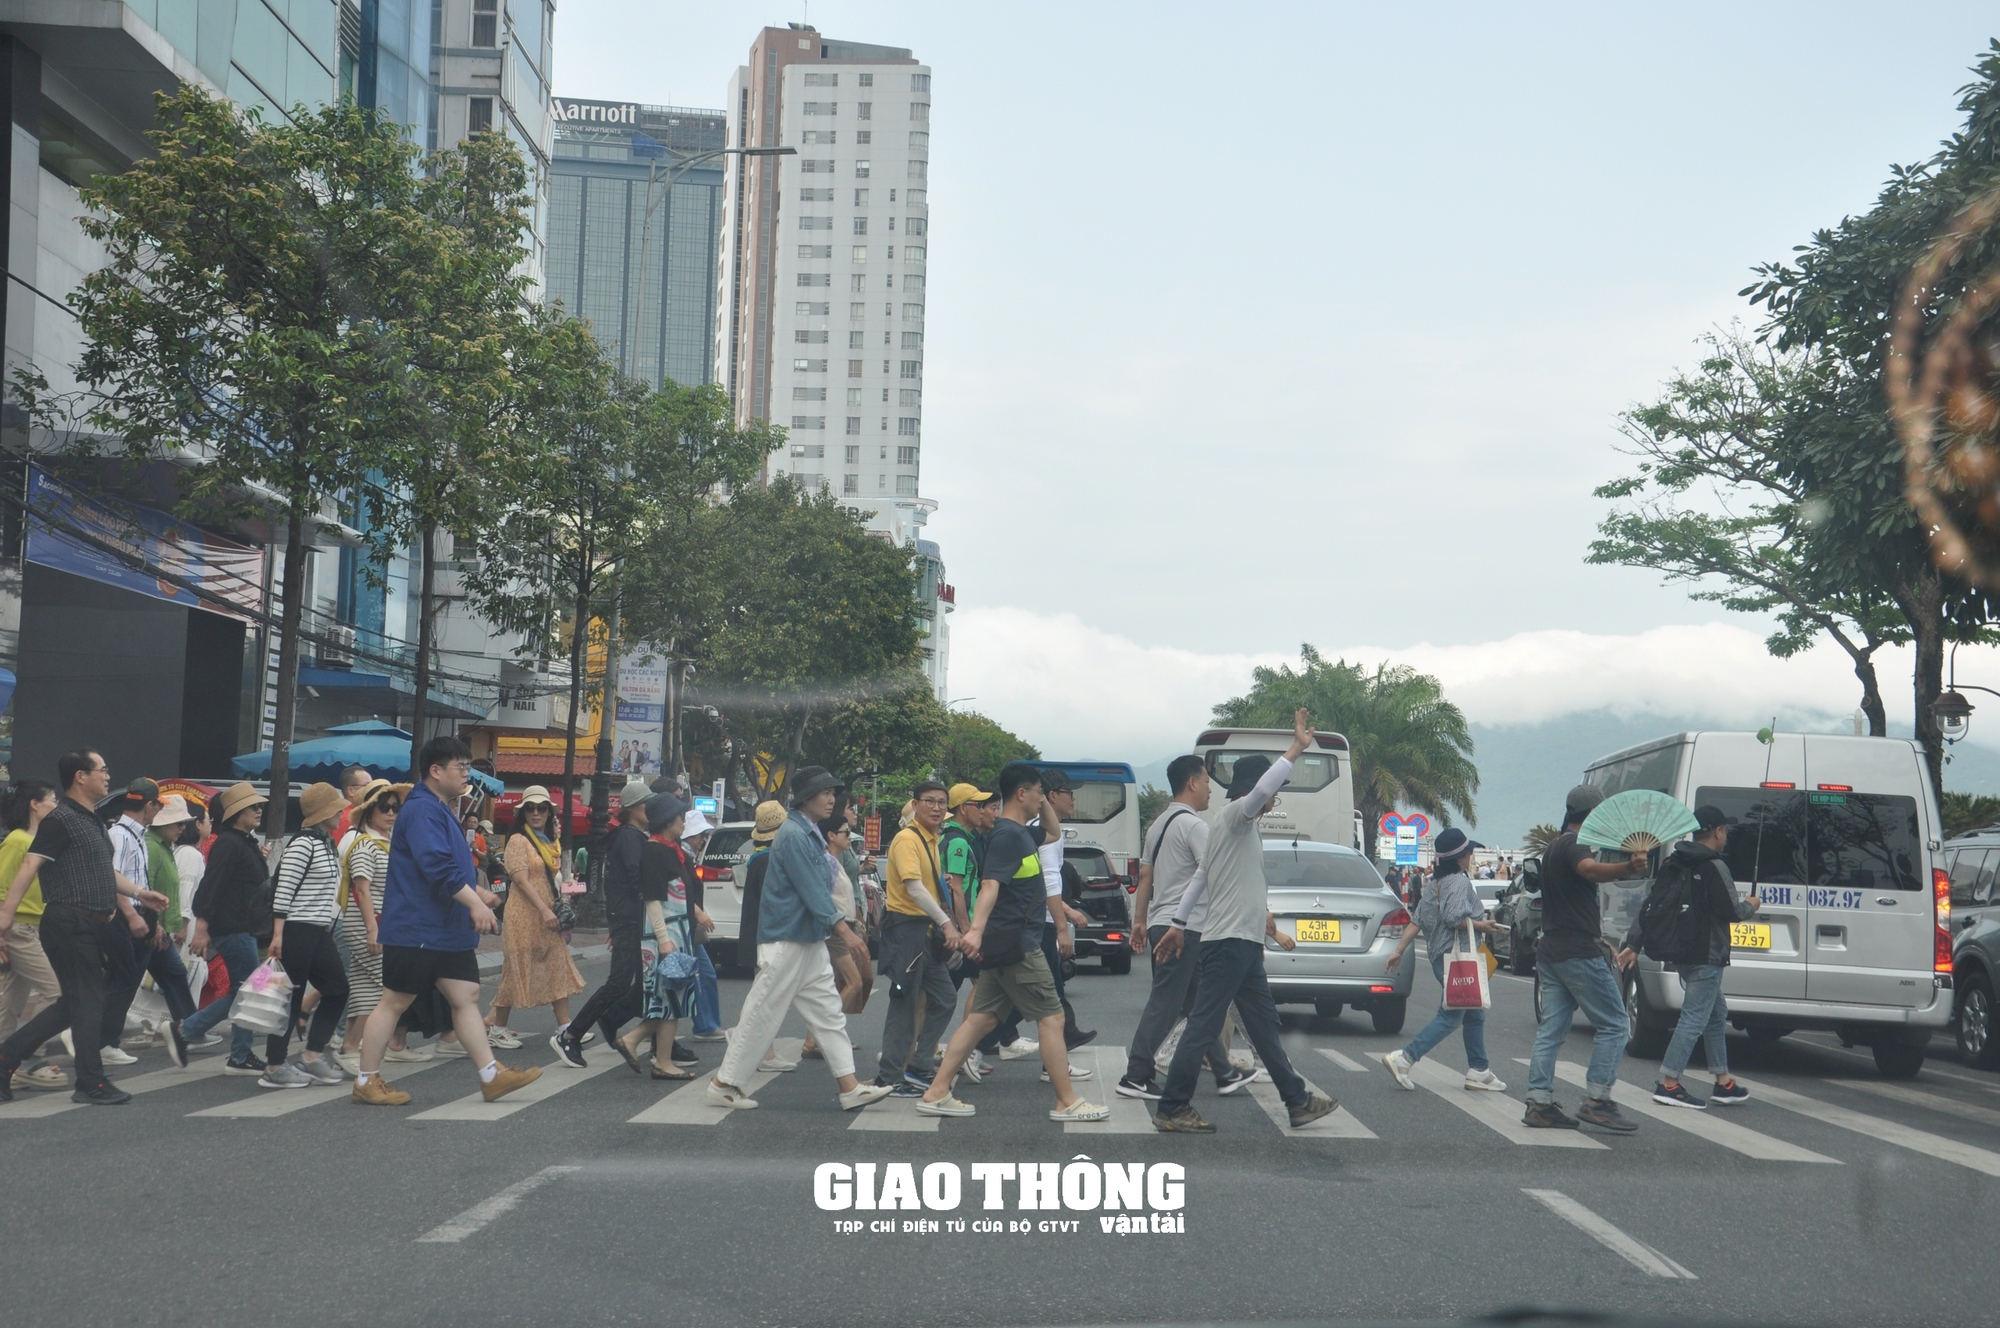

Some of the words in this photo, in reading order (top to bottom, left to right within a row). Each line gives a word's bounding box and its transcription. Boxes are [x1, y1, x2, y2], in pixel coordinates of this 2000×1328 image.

[550, 99, 636, 124] Marriott
[513, 700, 536, 712] NAIL
[1260, 822, 1296, 830] VERSE
[704, 853, 741, 861] VINASUN
[1759, 886, 1792, 906] 43H
[1808, 889, 1863, 909] 037.97
[1308, 920, 1328, 930] 43H
[1734, 924, 1756, 935] 43H
[1301, 931, 1336, 941] 040.87
[1730, 935, 1765, 947] 37.97
[1077, 1112, 1101, 1120] crocs
